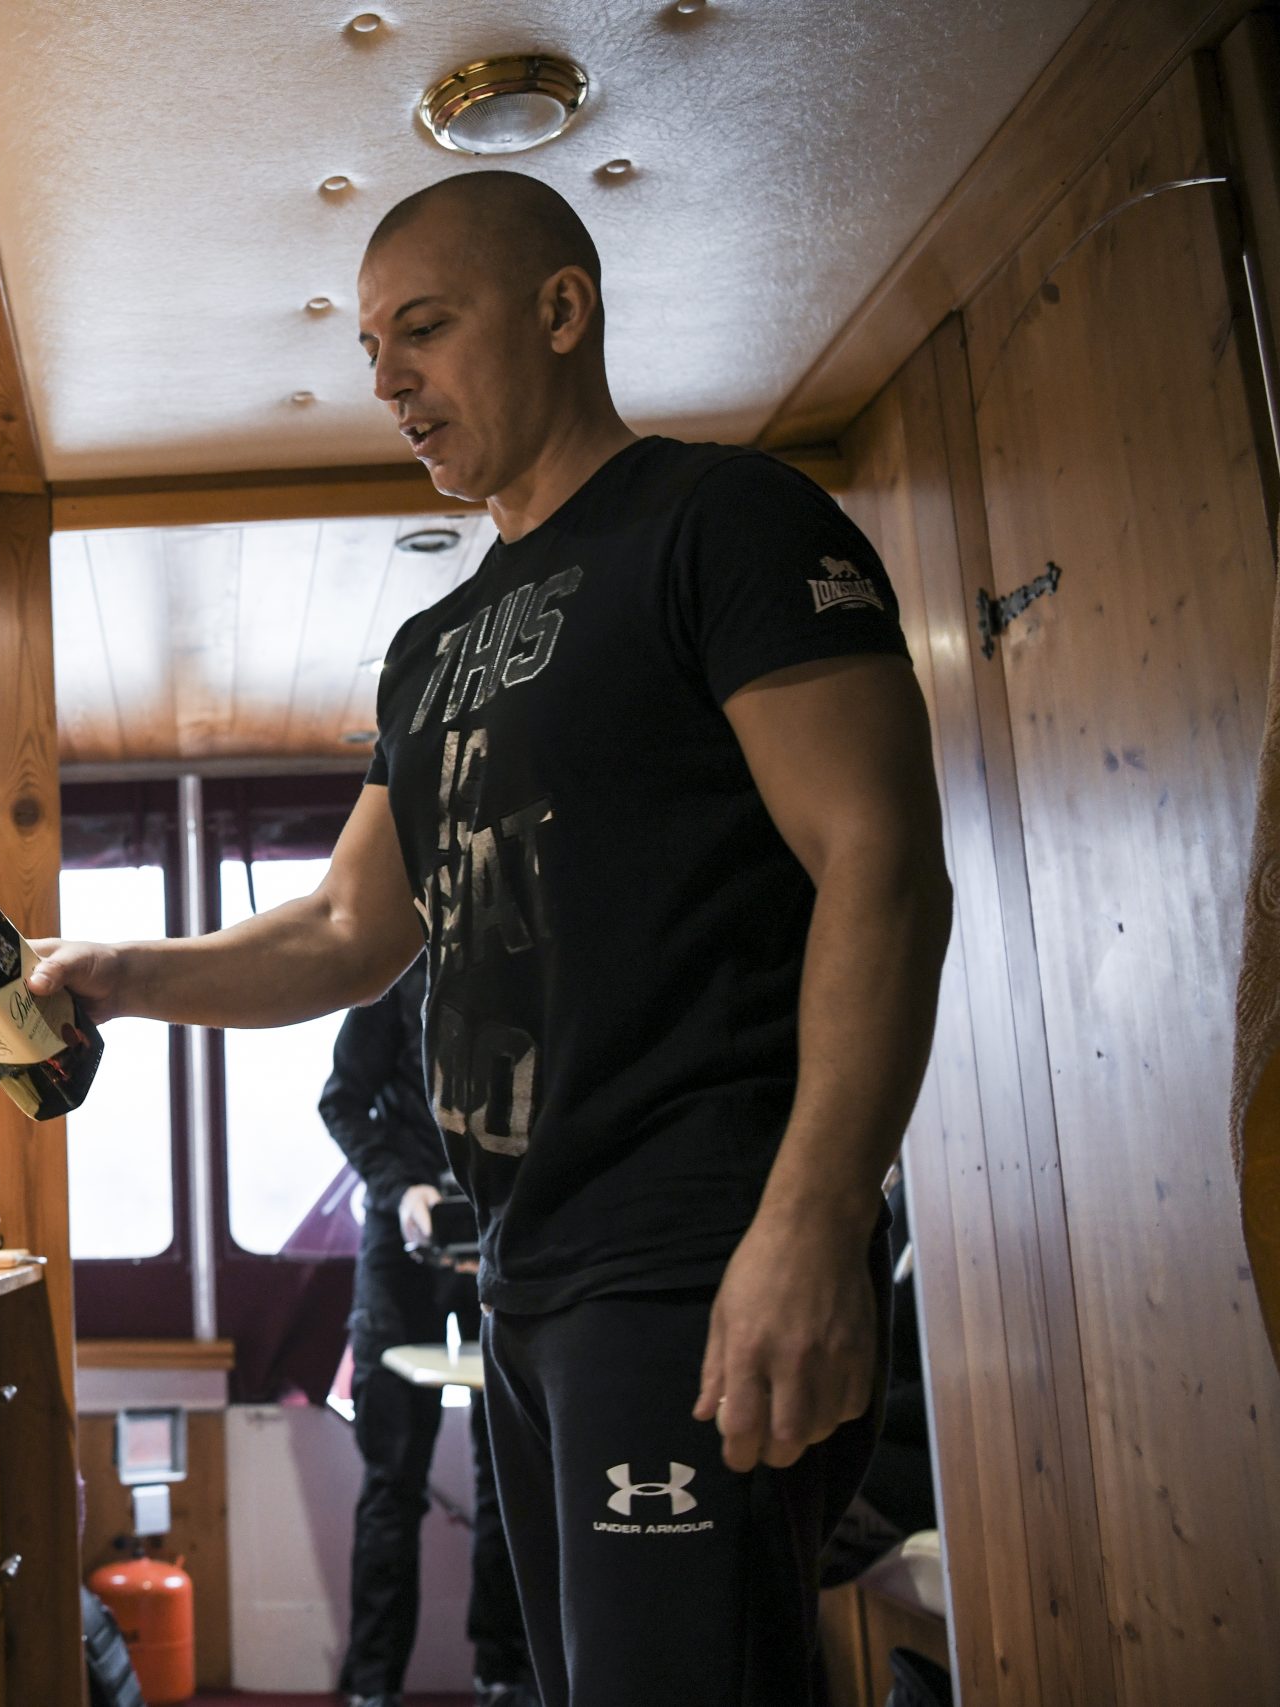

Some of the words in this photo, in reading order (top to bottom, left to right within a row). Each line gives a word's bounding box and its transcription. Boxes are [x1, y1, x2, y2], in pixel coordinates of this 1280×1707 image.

[807, 579, 884, 614] LONSDALE
[409, 564, 584, 735] THIS
[593, 1521, 640, 1533] UNDER
[646, 1521, 714, 1533] ARMOUR
